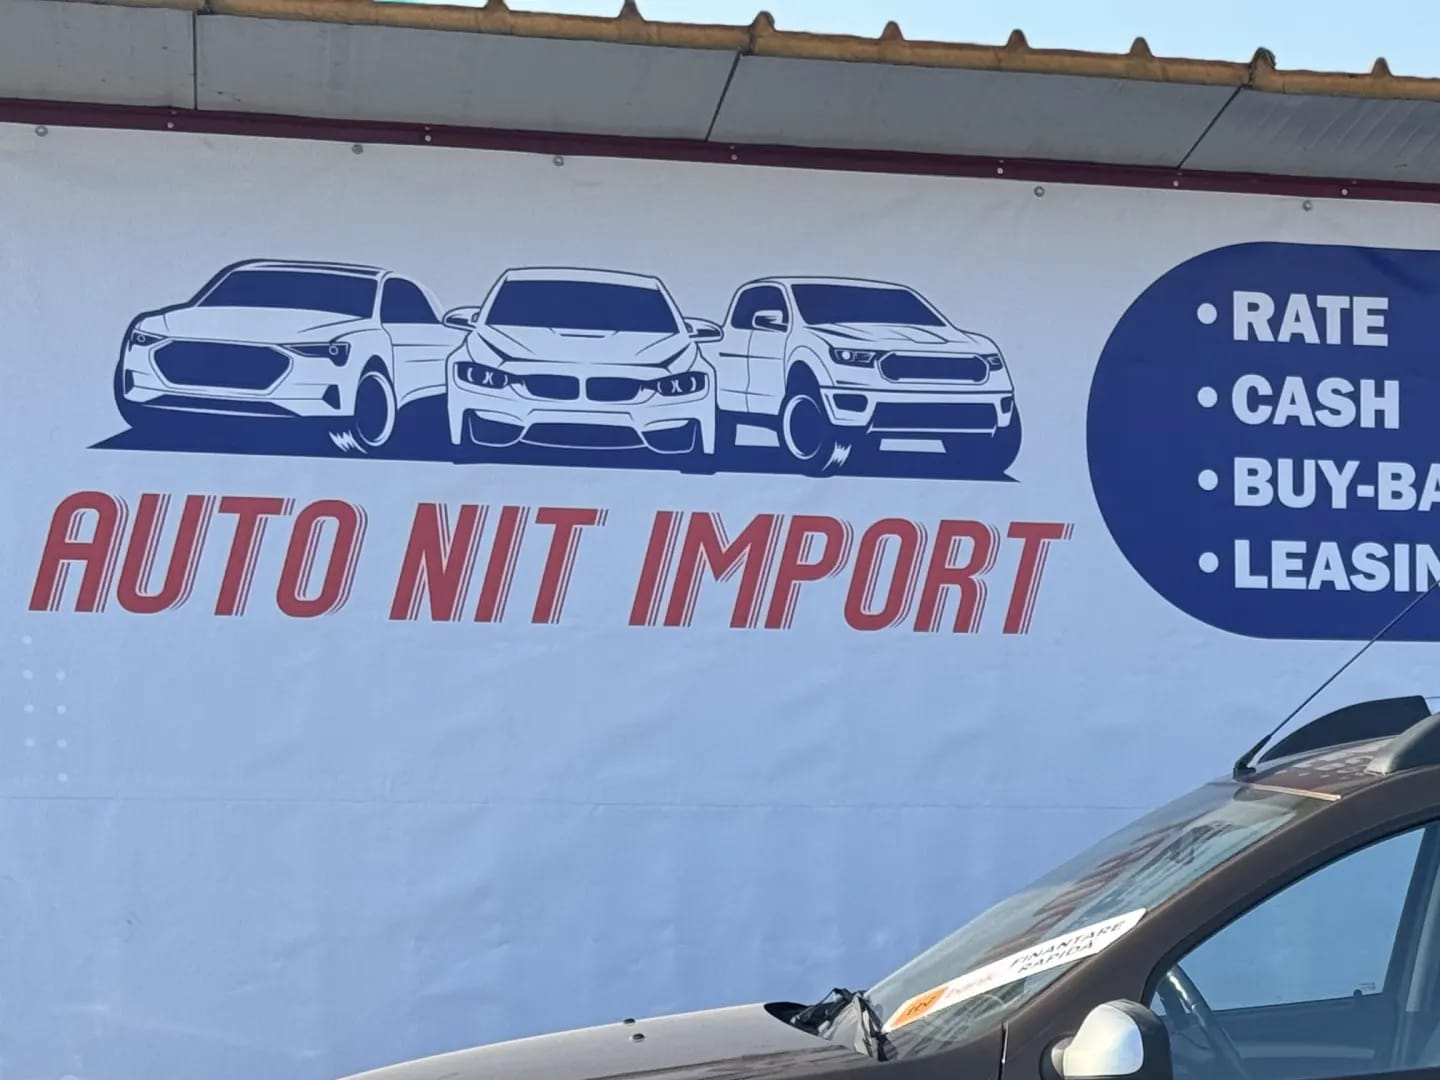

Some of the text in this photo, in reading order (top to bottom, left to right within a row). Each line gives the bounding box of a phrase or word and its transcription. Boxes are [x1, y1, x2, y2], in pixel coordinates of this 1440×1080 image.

[1233, 290, 1389, 347] RATE
[1232, 374, 1399, 429] CASH
[29, 491, 1073, 634] AUTO NIT IMPORT
[1017, 940, 1094, 974] RAPIDA
